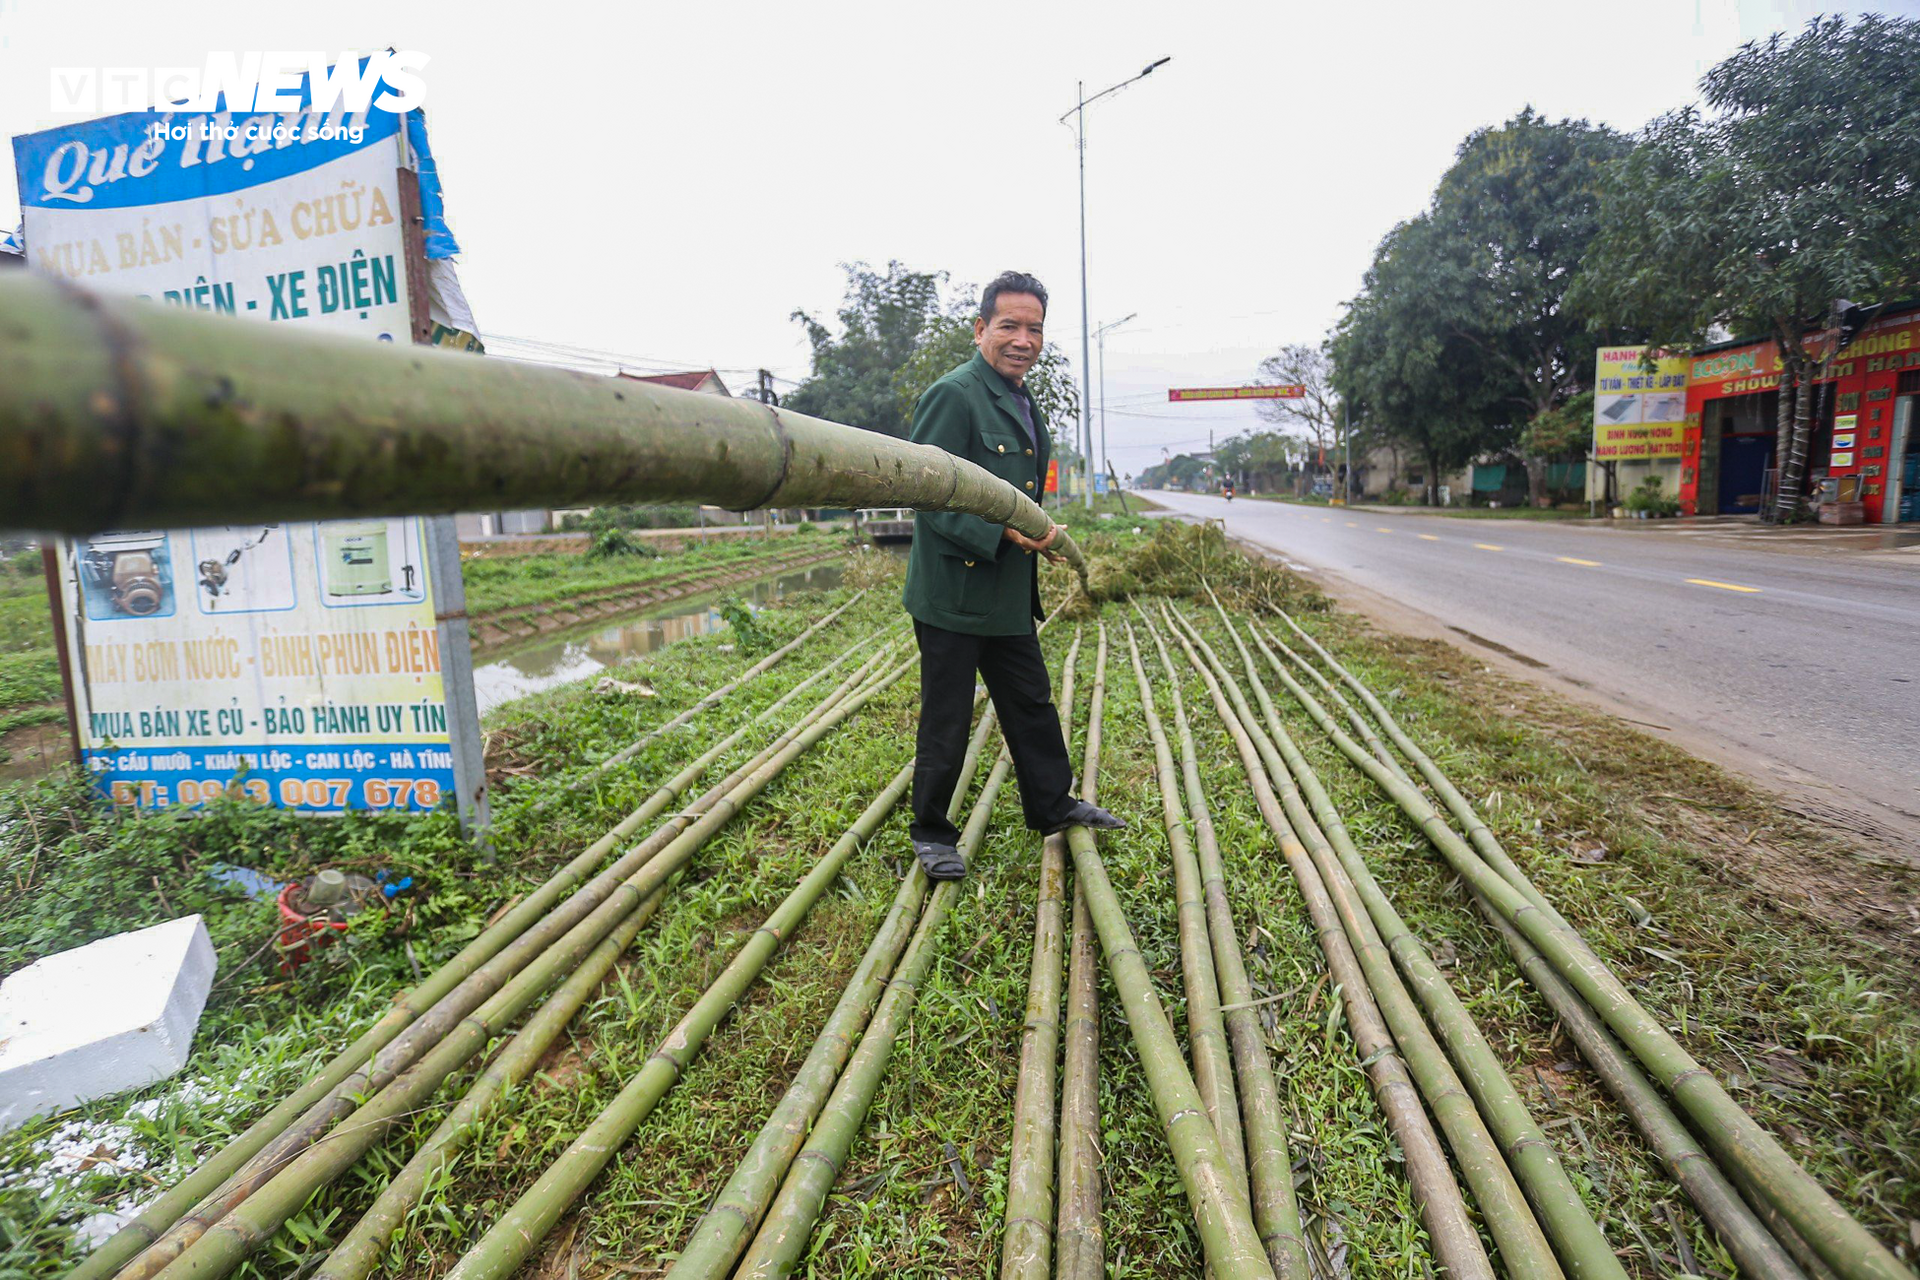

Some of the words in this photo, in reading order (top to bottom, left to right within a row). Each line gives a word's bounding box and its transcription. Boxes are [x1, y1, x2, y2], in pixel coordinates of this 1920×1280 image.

[38, 239, 111, 279] MUA
[116, 218, 184, 270] BÁN
[210, 199, 283, 254] SỬA
[291, 180, 395, 240] CHỮA
[266, 270, 309, 321] XE
[317, 249, 397, 320] ĐIỆN
[86, 636, 127, 684] MÁY
[133, 640, 180, 682] BƠM
[183, 627, 241, 680] NƯỚC
[260, 627, 315, 677] BÌNH
[317, 632, 381, 675] PHUN
[384, 621, 442, 683] ĐIỆN
[91, 711, 135, 739] MUA
[140, 706, 181, 738] BÁN
[186, 710, 212, 737] XE
[264, 695, 305, 735] BẢO
[311, 700, 371, 734] HÀNH
[375, 705, 403, 734] UY
[410, 698, 448, 733] TÍN
[261, 750, 293, 773] LỘC
[306, 752, 341, 770] CAN
[343, 749, 376, 773] LỘC
[390, 748, 415, 770] HÀ
[279, 778, 354, 807] 007
[363, 778, 441, 807] 678
